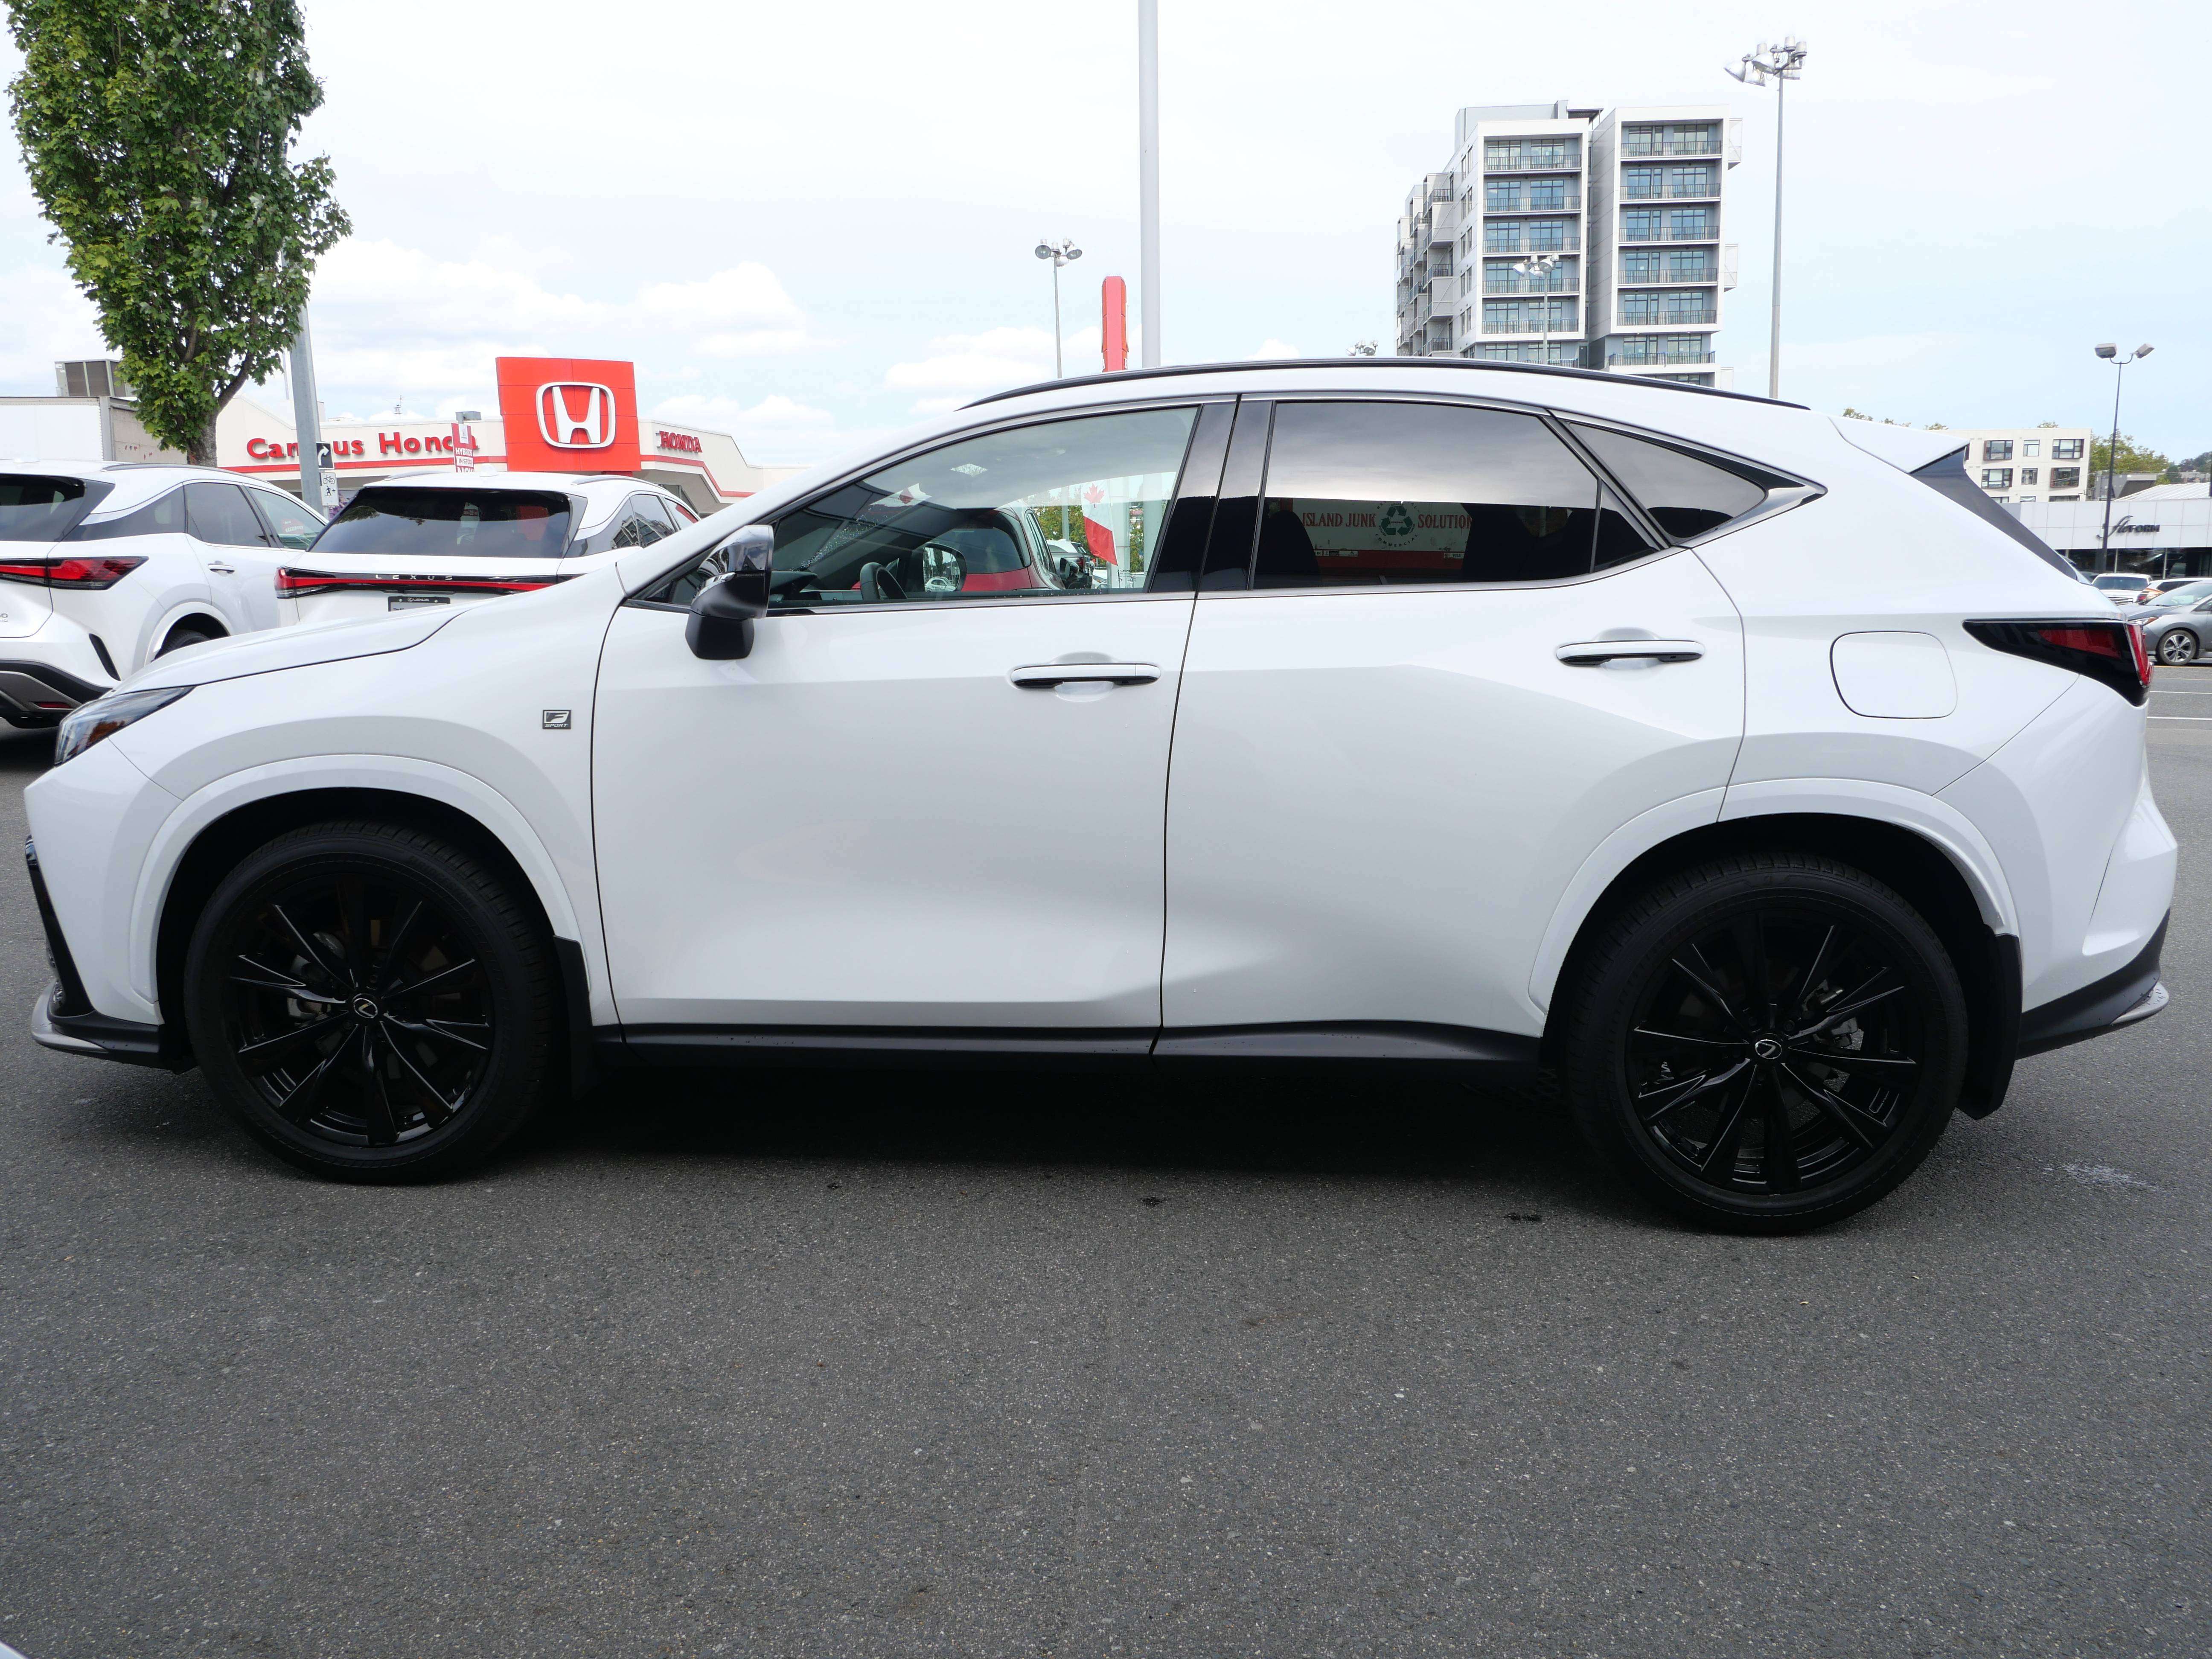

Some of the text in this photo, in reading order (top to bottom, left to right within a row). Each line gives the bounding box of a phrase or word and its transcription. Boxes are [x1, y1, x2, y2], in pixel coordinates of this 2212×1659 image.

[246, 437, 363, 459] Caus
[658, 431, 703, 453] HONDA
[1302, 512, 1344, 527] ISLAND
[1345, 513, 1377, 528] JUNK
[1375, 533, 1418, 547] COMMERCIAL
